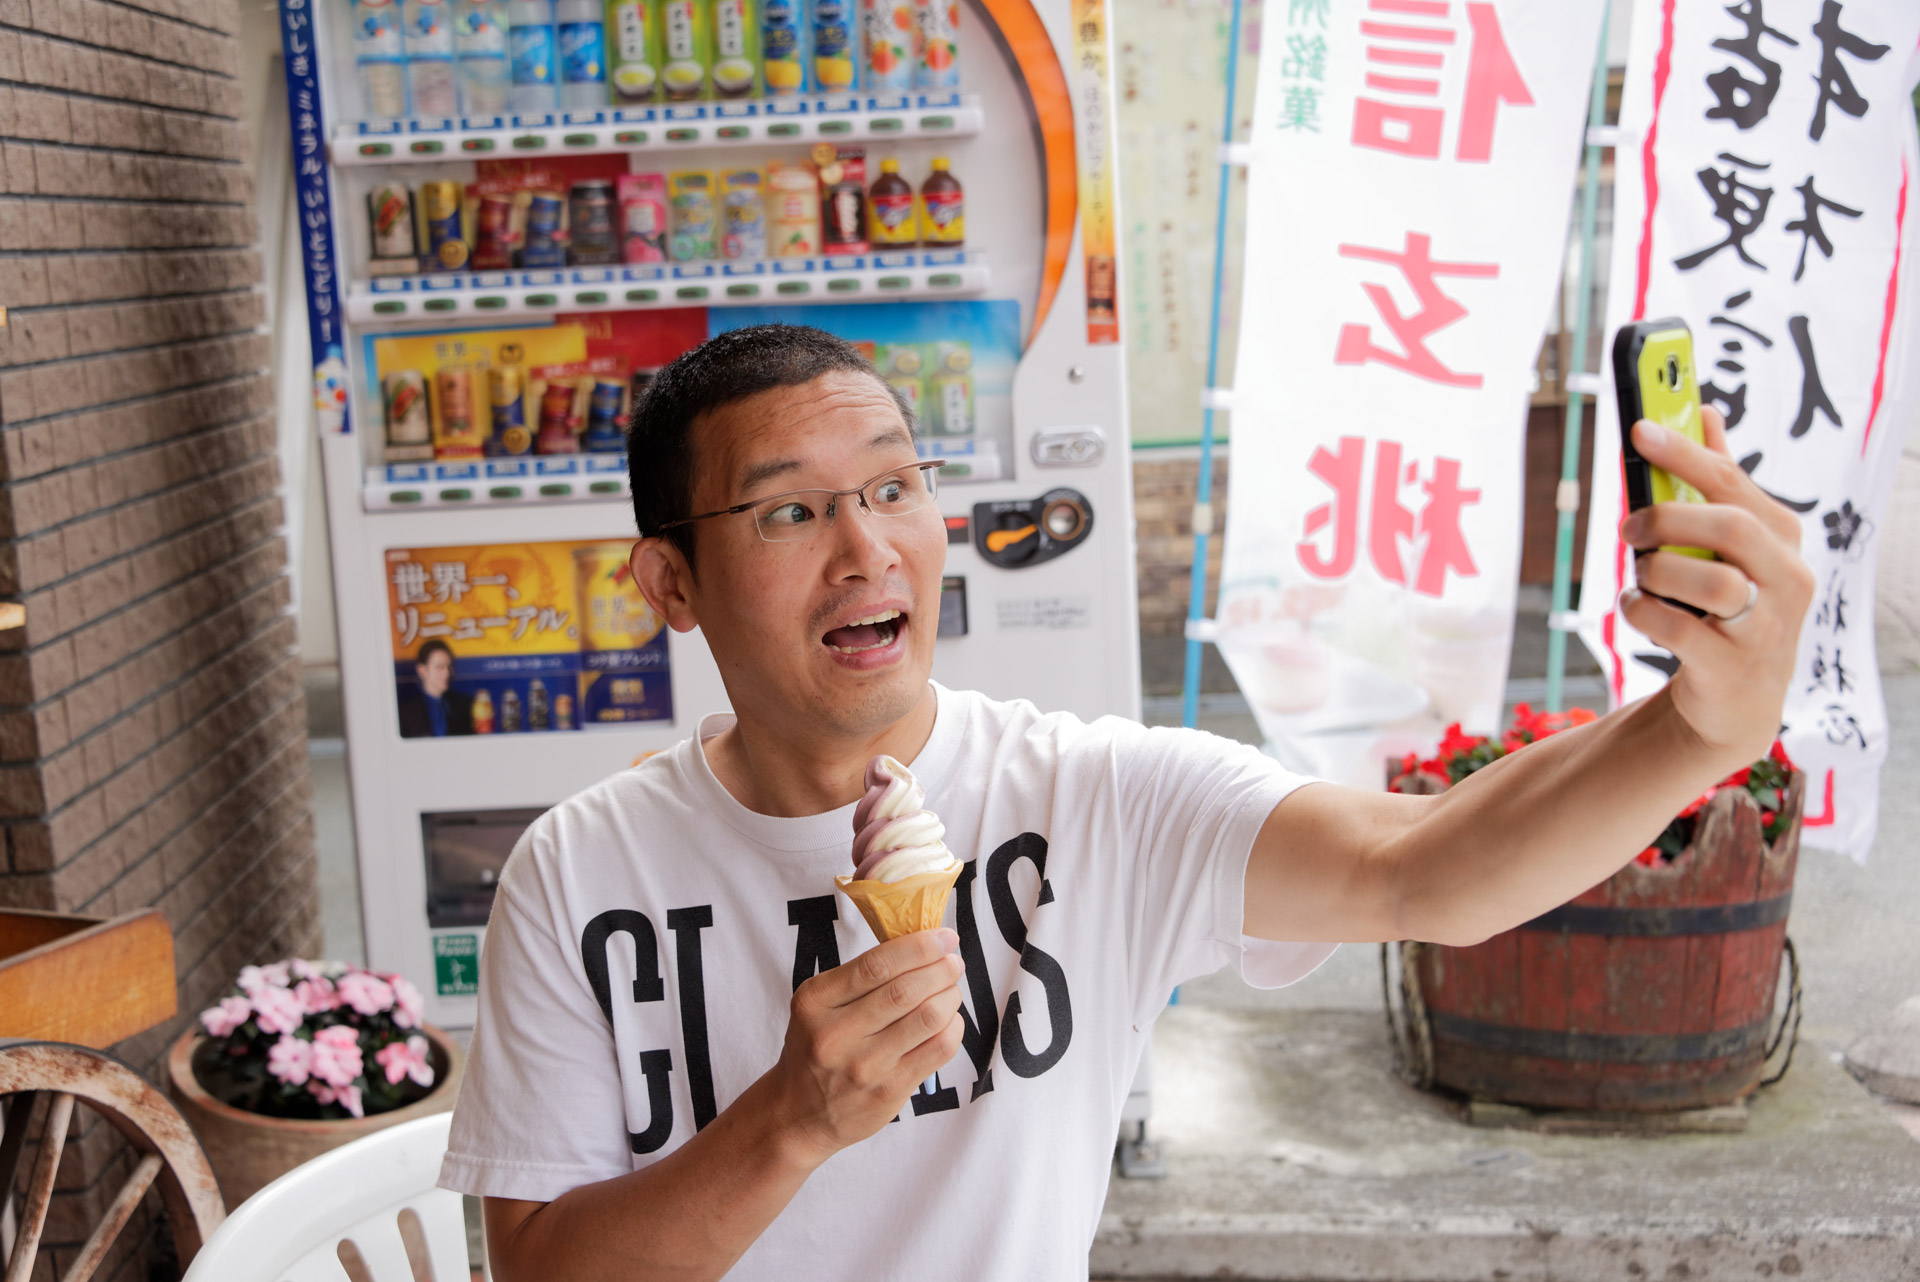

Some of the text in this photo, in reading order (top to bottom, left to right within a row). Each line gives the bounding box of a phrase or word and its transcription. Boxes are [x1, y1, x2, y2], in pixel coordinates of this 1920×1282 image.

[391, 560, 520, 606] 世界一、
[395, 604, 580, 648] リニューアル。
